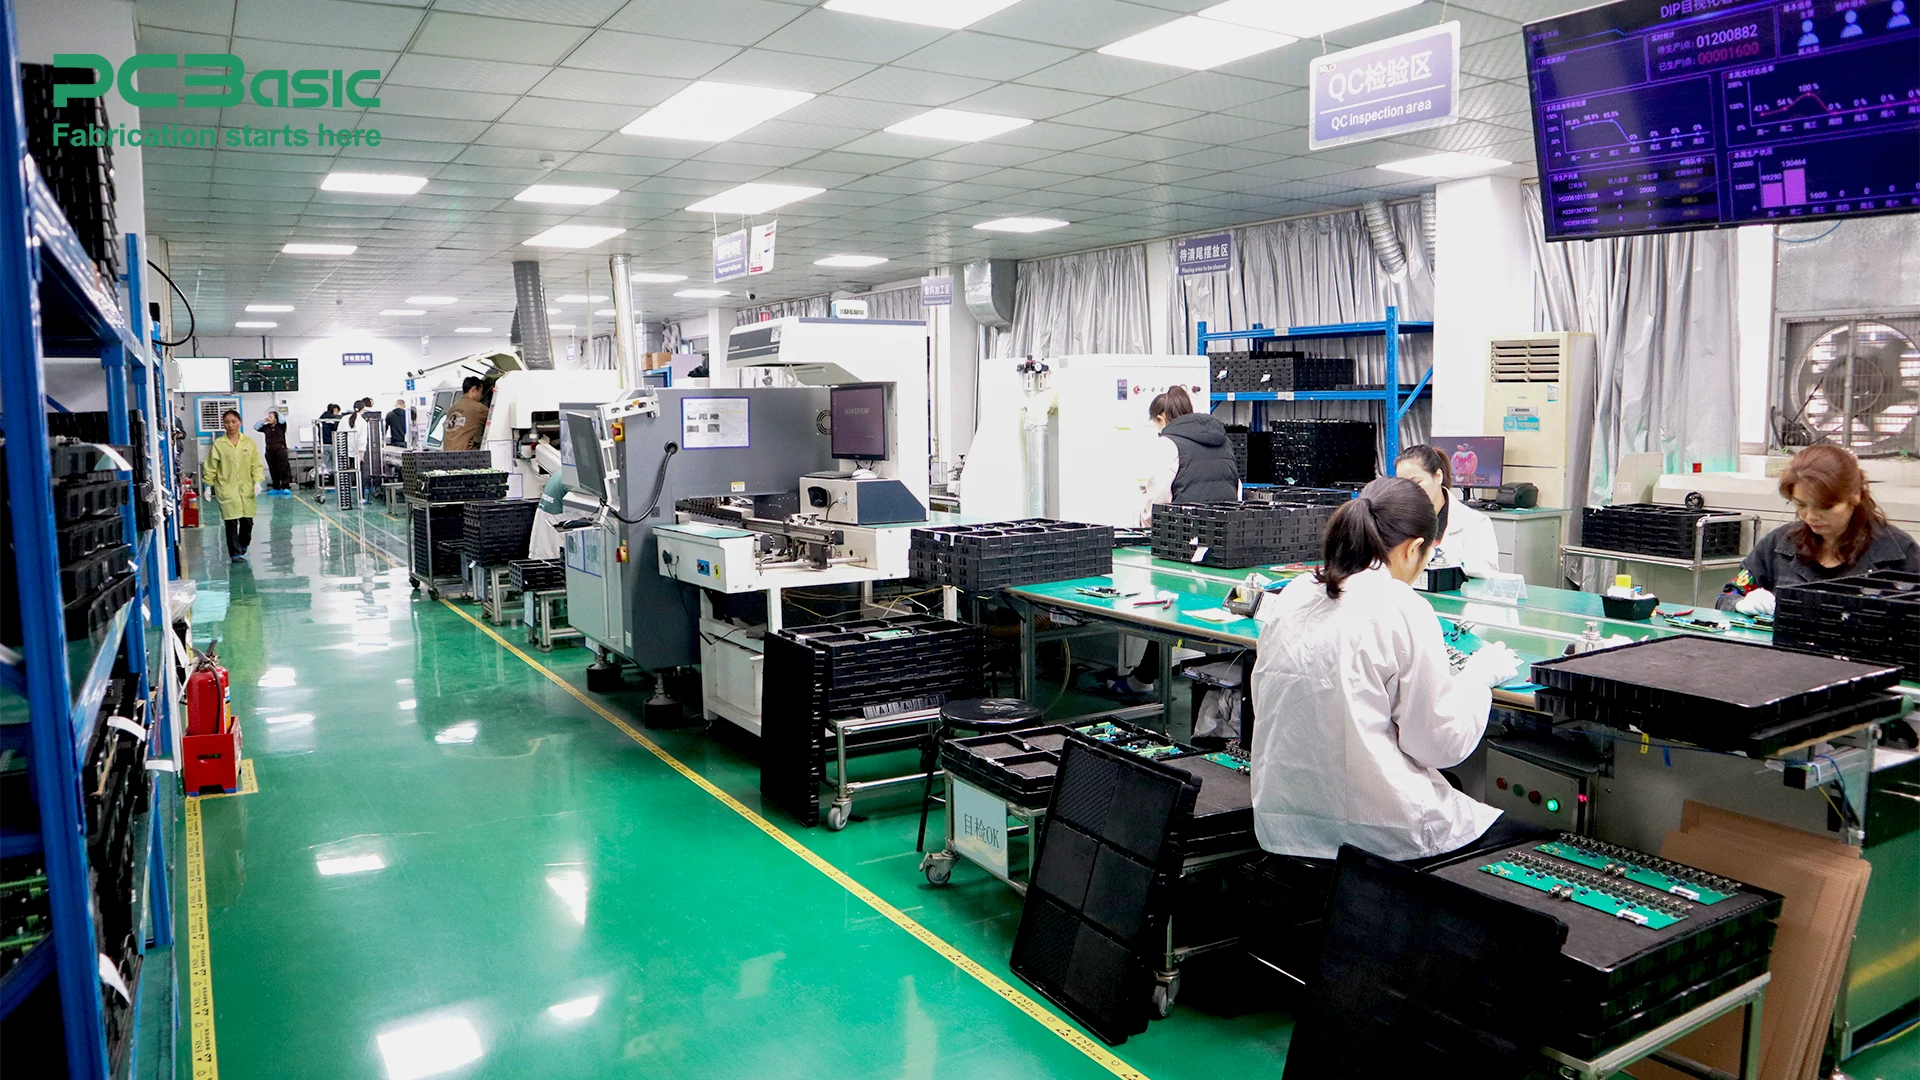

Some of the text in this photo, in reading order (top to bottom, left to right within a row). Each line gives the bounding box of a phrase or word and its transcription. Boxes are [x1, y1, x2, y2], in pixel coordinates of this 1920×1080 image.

[1696, 24, 1758, 48] 01200882
[1698, 42, 1759, 65] 00001600
[1328, 50, 1432, 103] QC检验区
[1331, 99, 1432, 131] QC inspection area
[1614, 189, 1624, 197] null
[1639, 186, 1657, 194] 20000
[1179, 243, 1229, 263] 待清尾摆放区
[964, 813, 1000, 849] 目检OK
